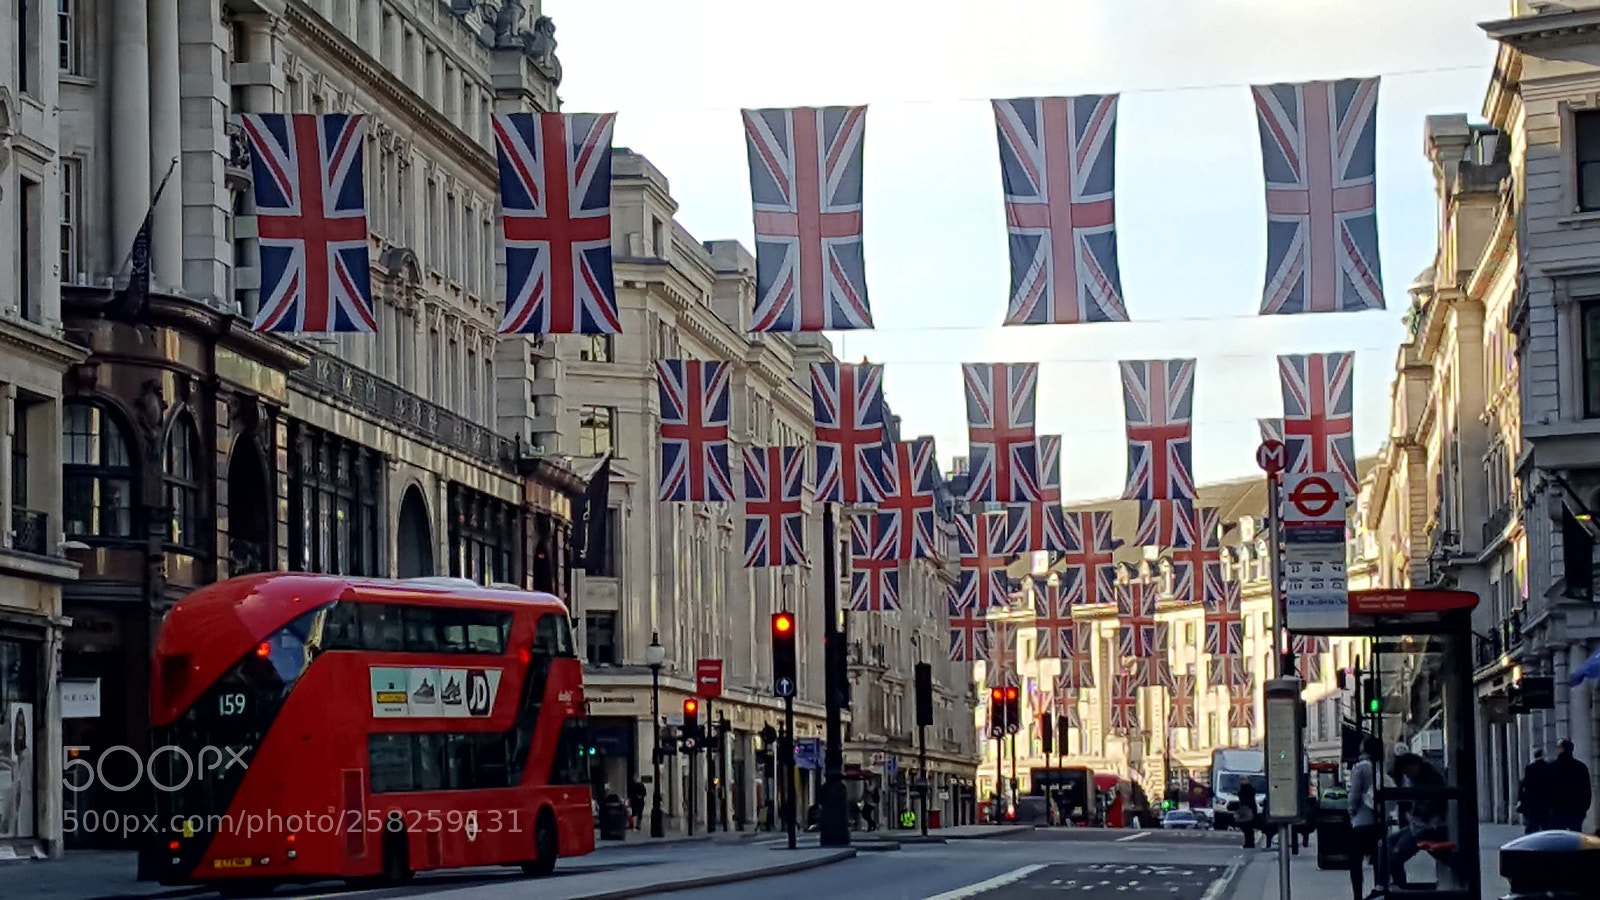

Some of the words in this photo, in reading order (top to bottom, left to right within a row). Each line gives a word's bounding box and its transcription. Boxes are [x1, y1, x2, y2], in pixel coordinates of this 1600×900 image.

[1261, 445, 1284, 467] M
[468, 674, 488, 711] JD
[219, 693, 246, 717] 159
